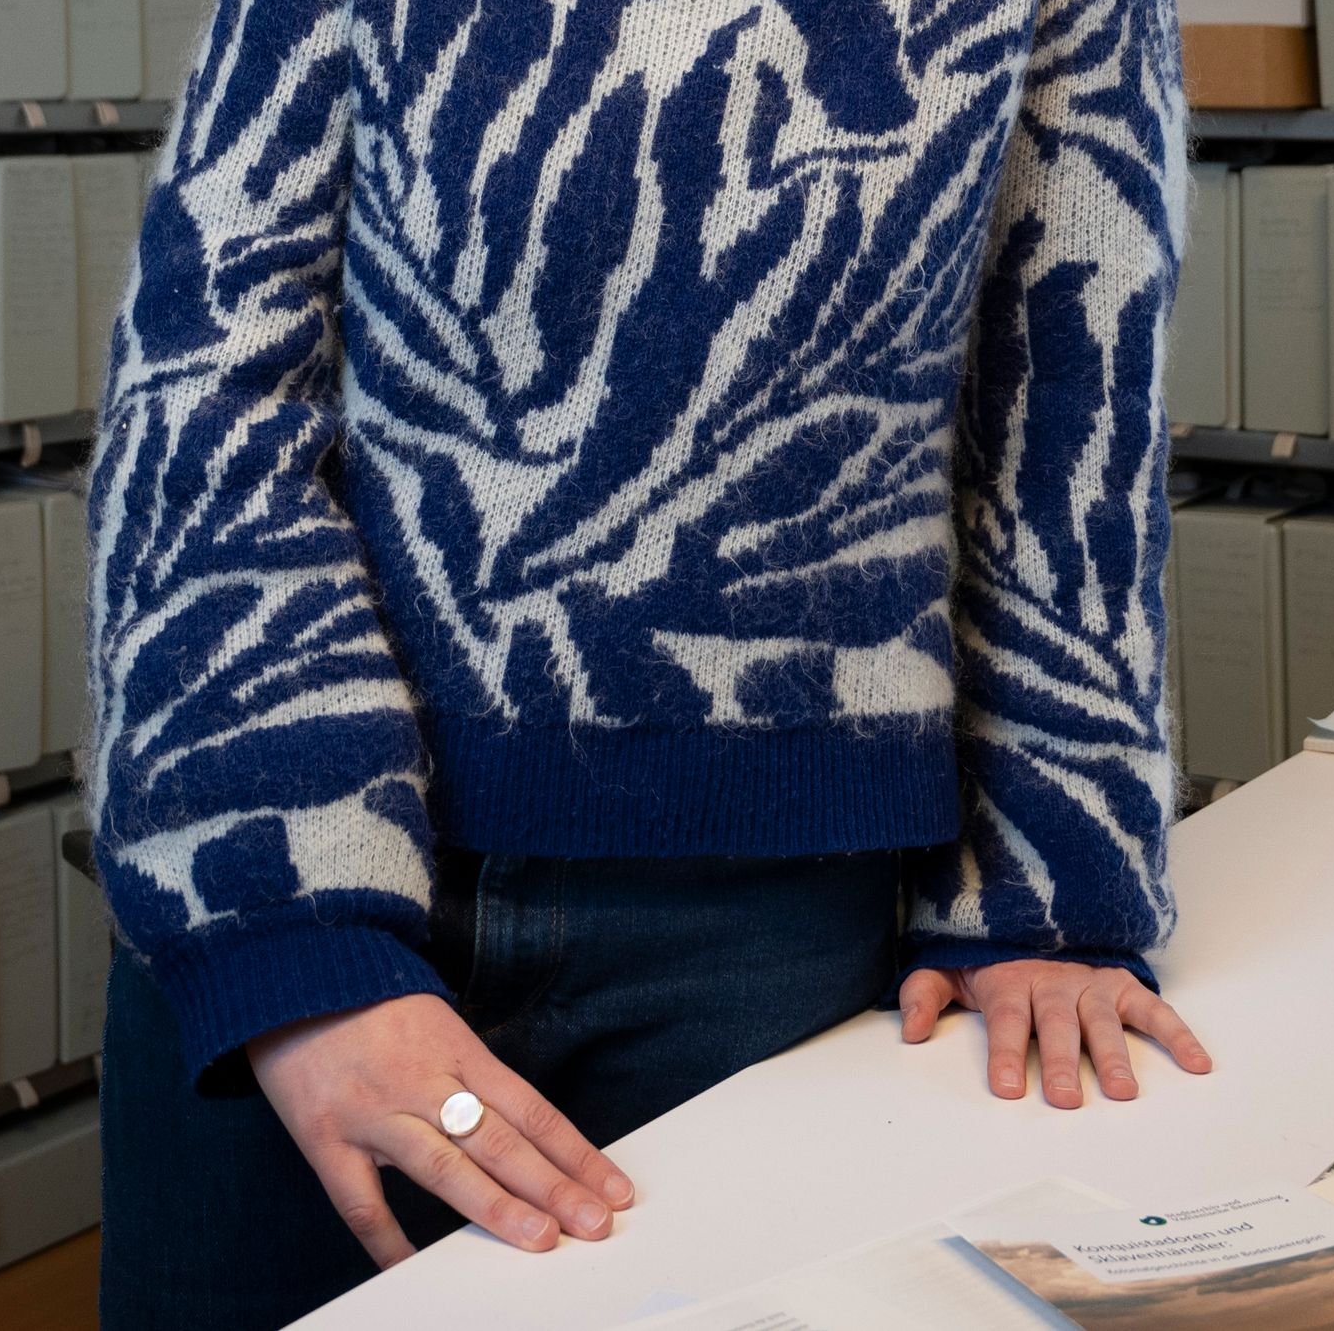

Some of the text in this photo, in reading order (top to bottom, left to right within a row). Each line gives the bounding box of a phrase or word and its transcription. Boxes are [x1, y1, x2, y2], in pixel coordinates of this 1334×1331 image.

[1073, 1221, 1255, 1254] Konquistadoren und
[1087, 1240, 1233, 1264] Sklavenhändler:
